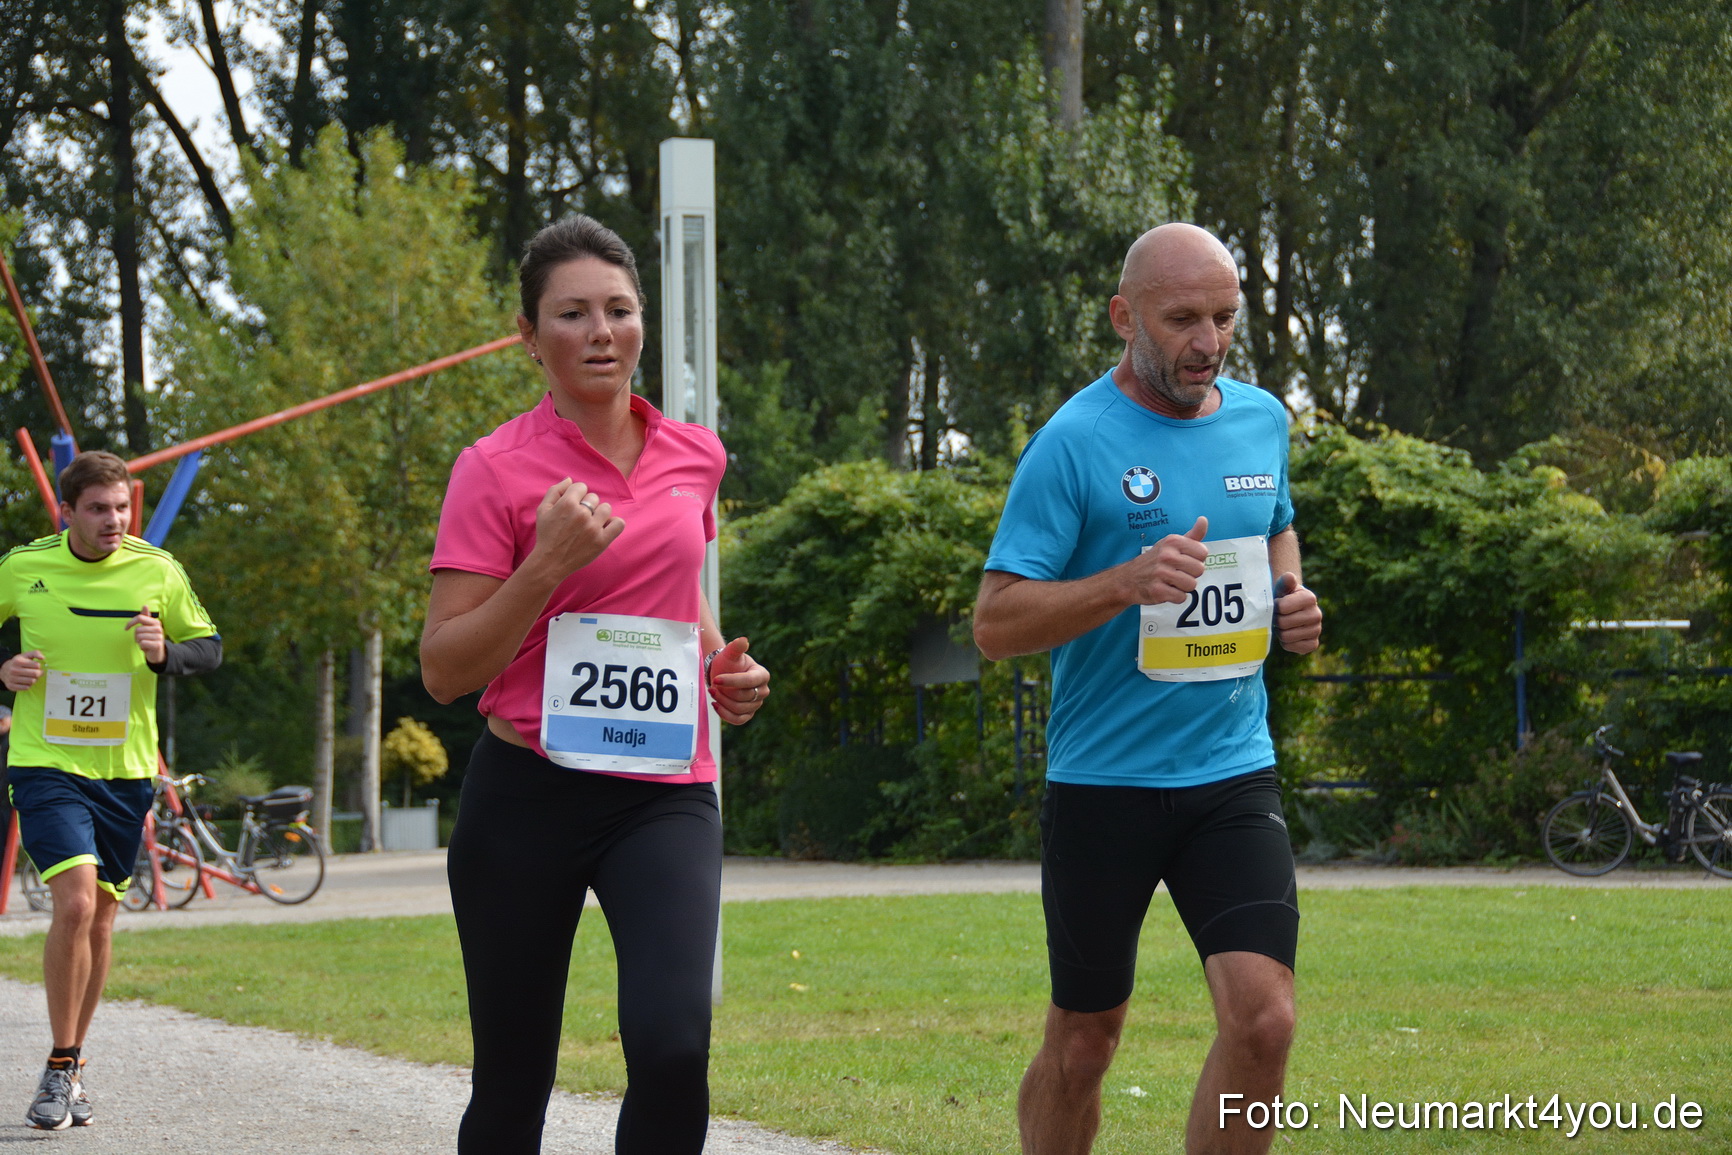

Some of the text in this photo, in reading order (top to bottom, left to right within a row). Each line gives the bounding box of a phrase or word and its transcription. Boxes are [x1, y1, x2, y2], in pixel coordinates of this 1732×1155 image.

[1123, 467, 1155, 482] BMW
[1223, 474, 1277, 492] BOCK
[1127, 507, 1168, 523] PARTL
[1128, 517, 1169, 531] Neumarkt
[1204, 552, 1238, 567] OCK
[1176, 582, 1245, 629] 205
[613, 629, 662, 647] BOCK
[1185, 642, 1237, 658] Thomas
[569, 661, 679, 714] 2566
[66, 694, 106, 717] 121
[553, 699, 560, 708] C
[72, 723, 99, 733] Stefan
[602, 726, 647, 748] Nadja
